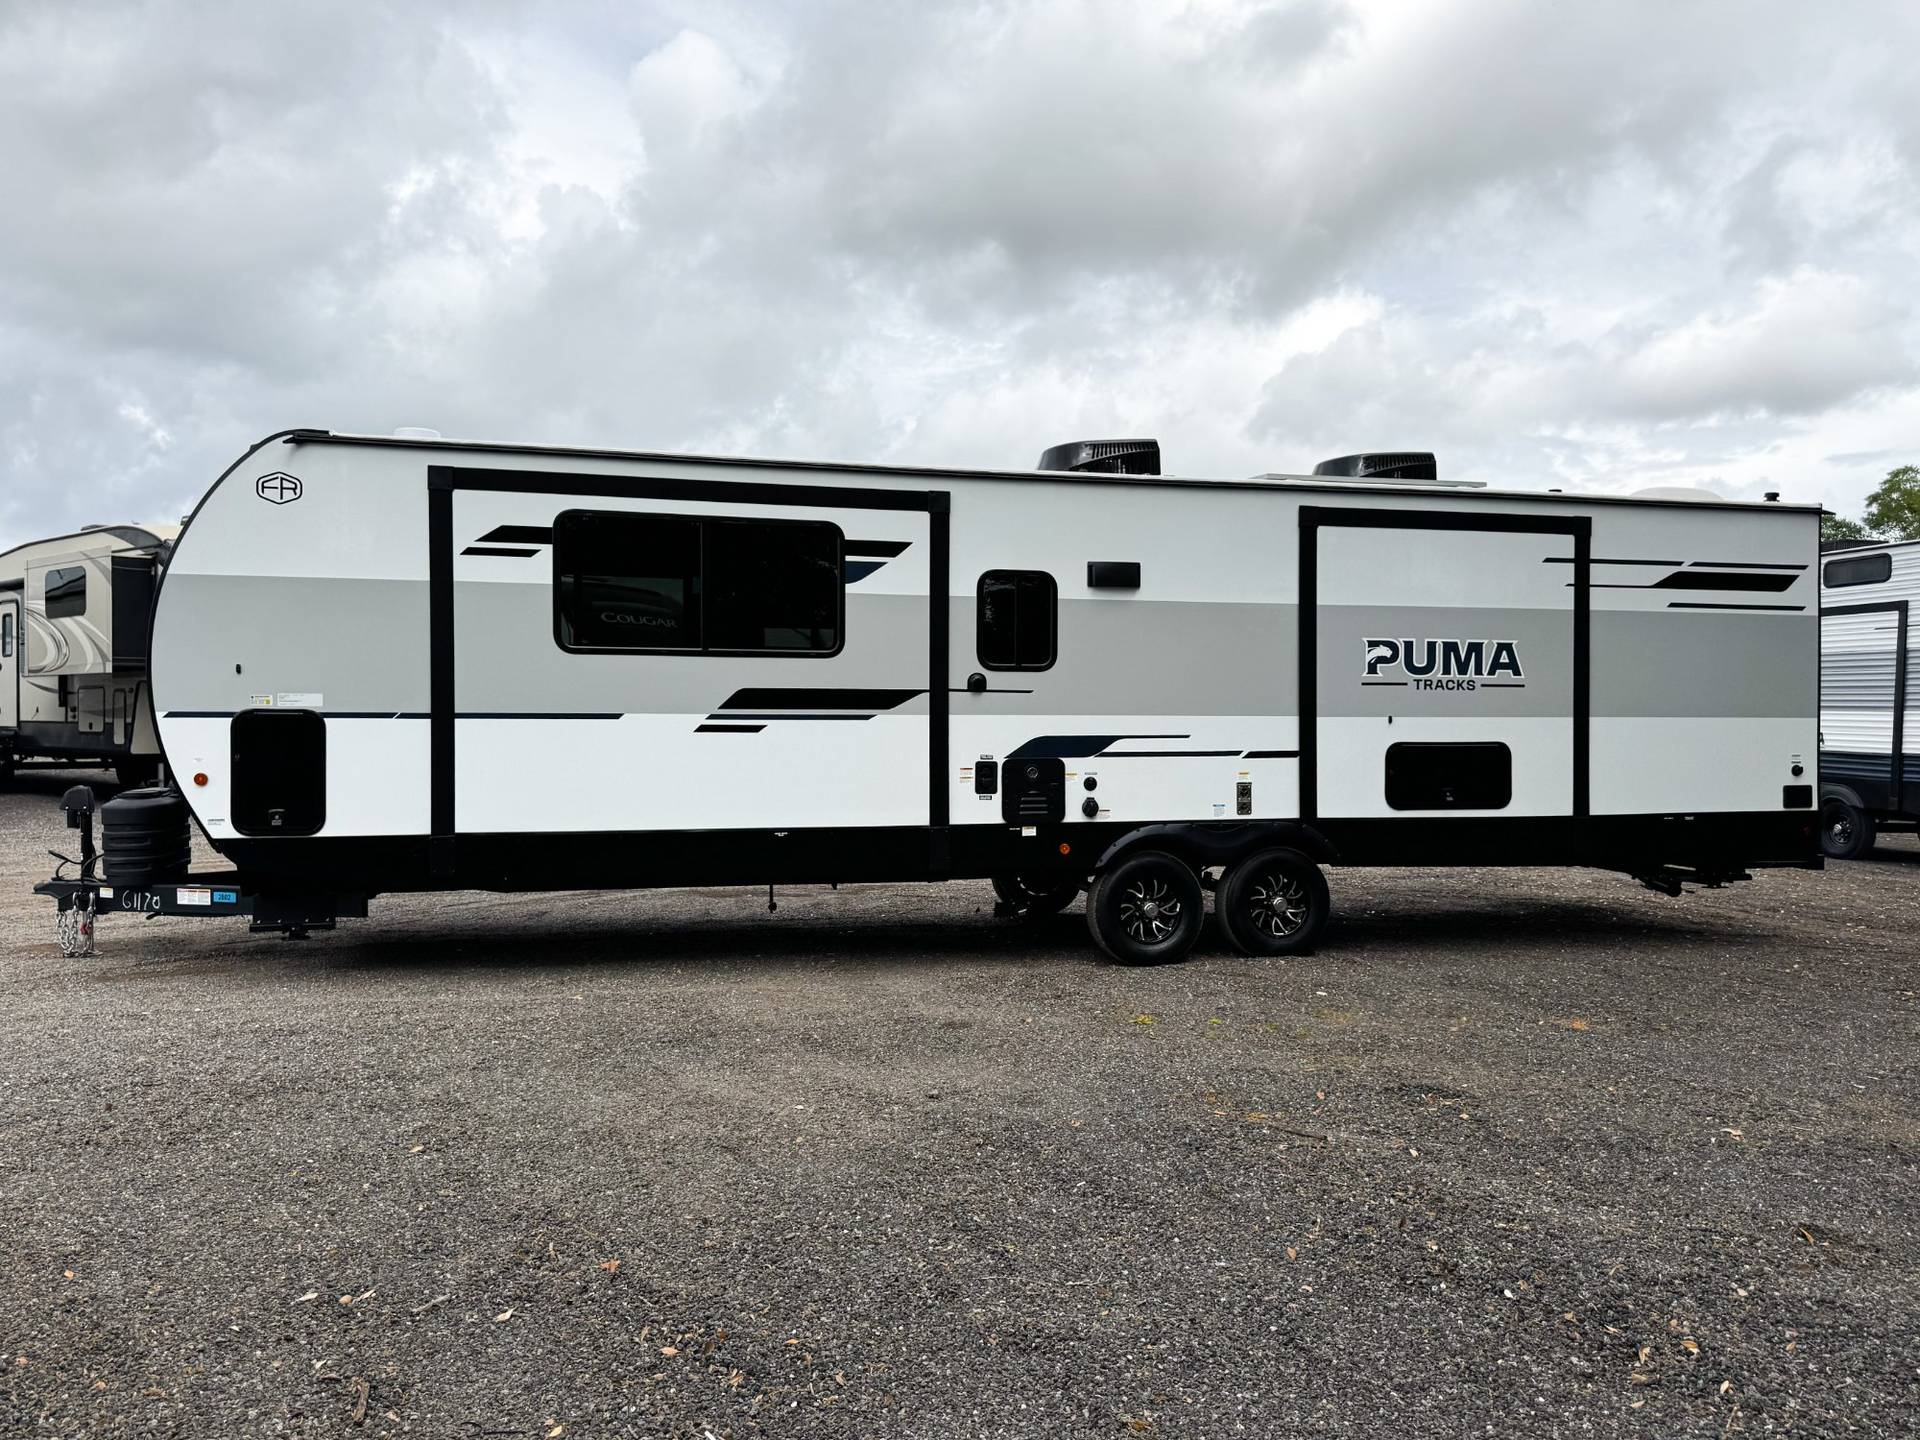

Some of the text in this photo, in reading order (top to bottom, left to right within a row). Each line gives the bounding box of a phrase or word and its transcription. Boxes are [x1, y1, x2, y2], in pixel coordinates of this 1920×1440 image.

[600, 612, 679, 628] COUGAR
[1362, 638, 1525, 678] PUMA
[1413, 679, 1477, 691] TRACKS
